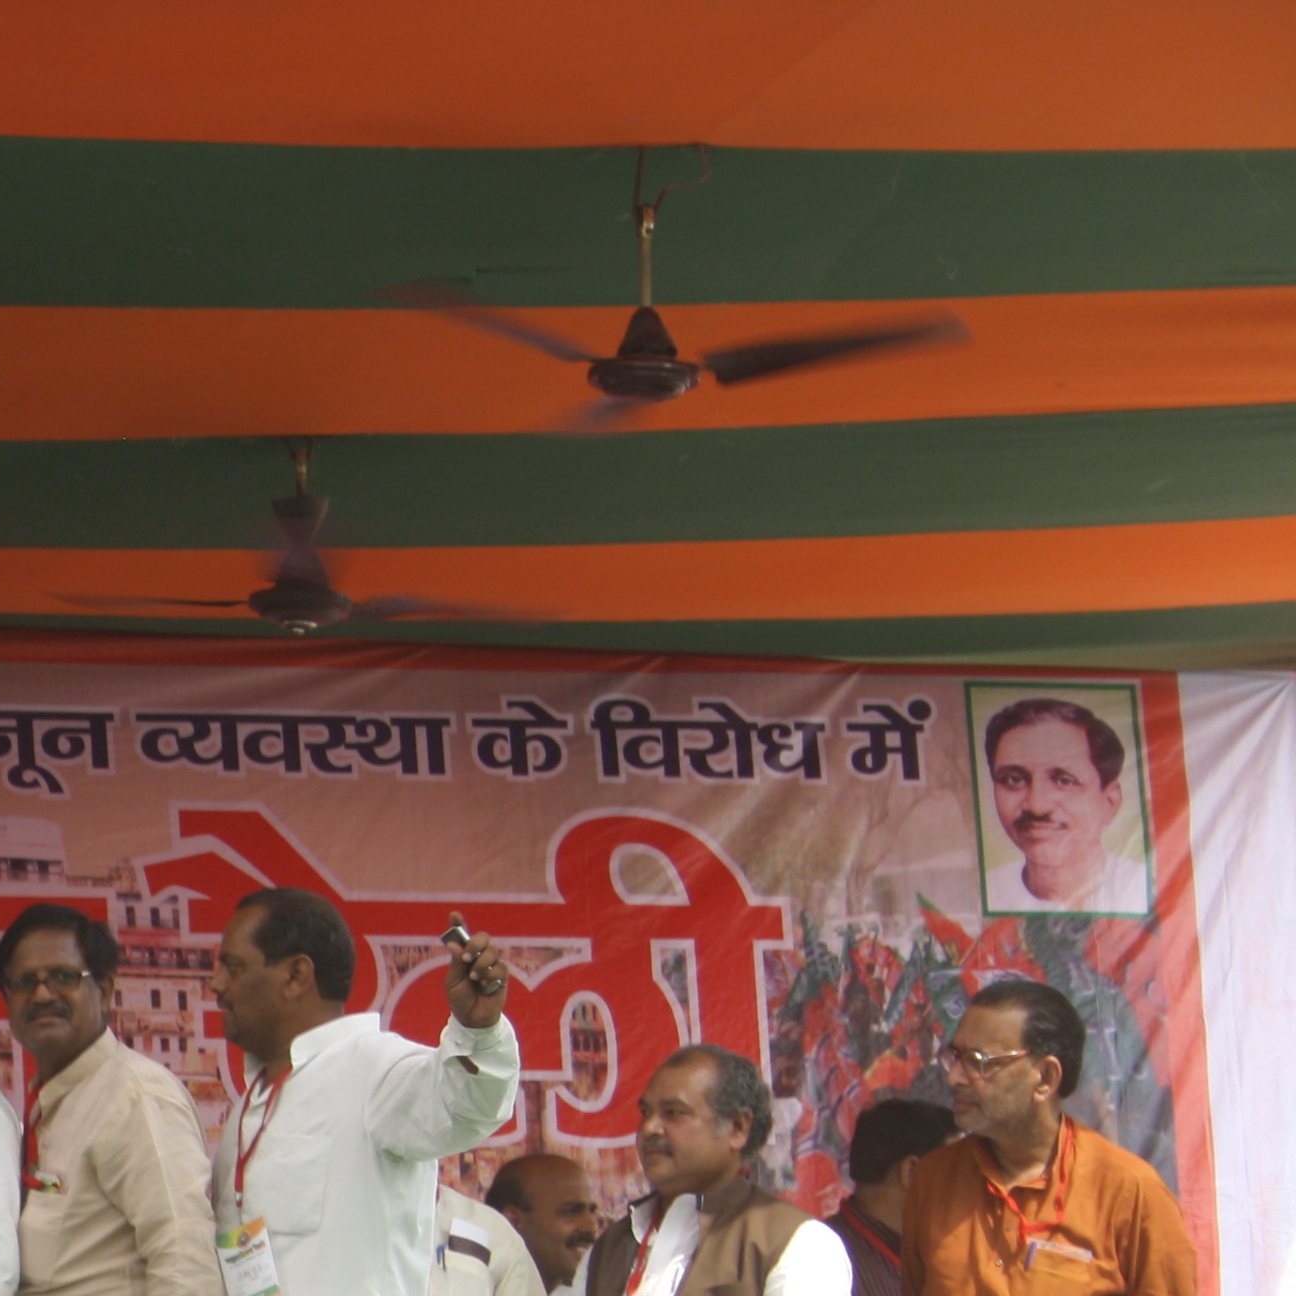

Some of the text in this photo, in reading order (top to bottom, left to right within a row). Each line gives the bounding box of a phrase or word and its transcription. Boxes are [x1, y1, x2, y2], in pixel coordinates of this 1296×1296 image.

[134, 711, 452, 777] व्यवस्था
[470, 699, 569, 777] के
[590, 698, 824, 779] विरोध
[846, 699, 935, 780] में
